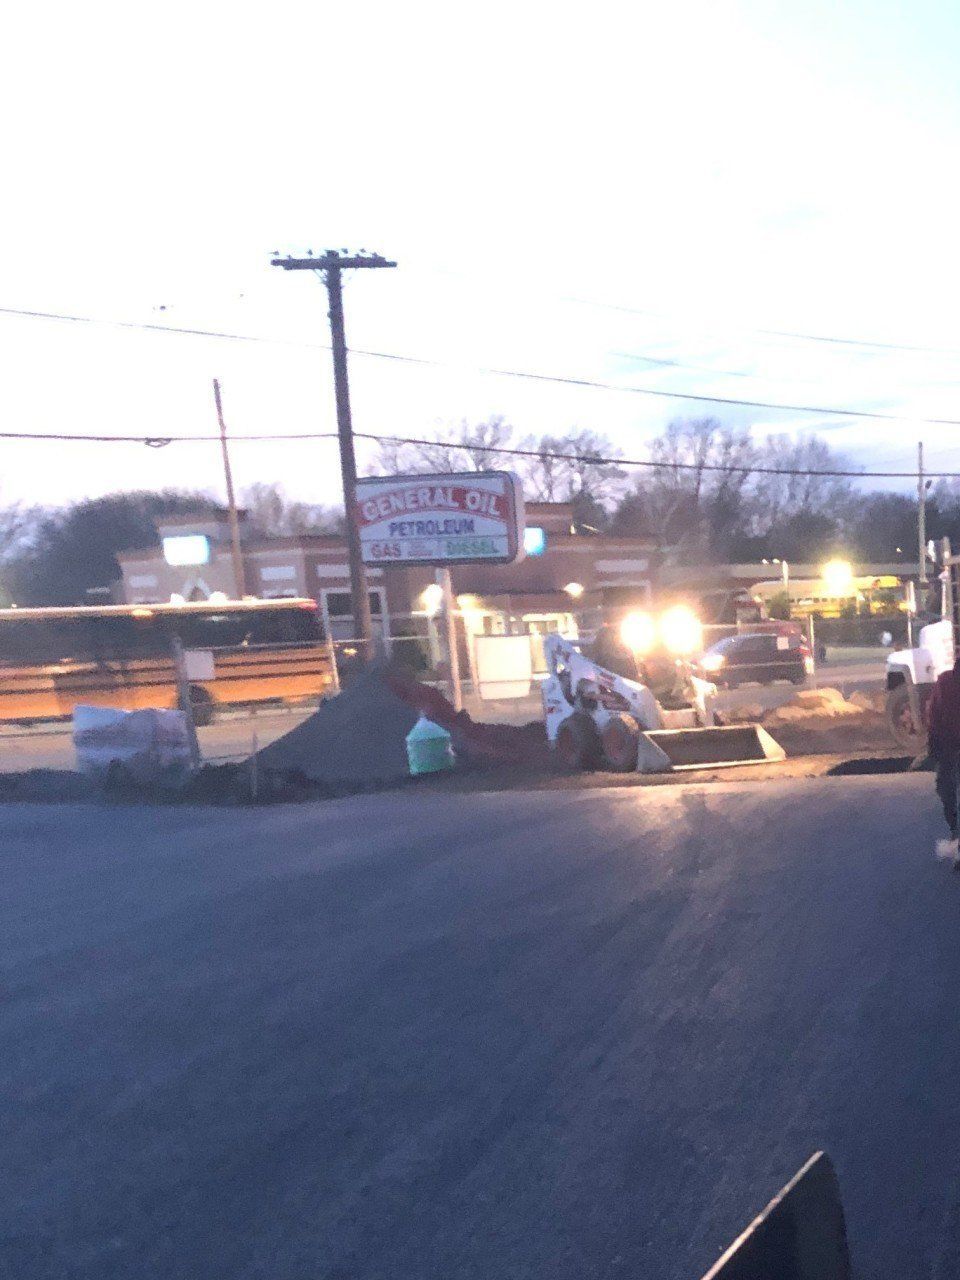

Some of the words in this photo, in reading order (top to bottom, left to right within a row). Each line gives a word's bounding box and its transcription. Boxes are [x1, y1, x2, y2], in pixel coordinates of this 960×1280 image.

[361, 486, 459, 521] GENERAL
[465, 490, 501, 516] OIL
[389, 518, 476, 537] PETROLEUM
[370, 542, 402, 558] GAS
[446, 539, 500, 556] DIESEL
